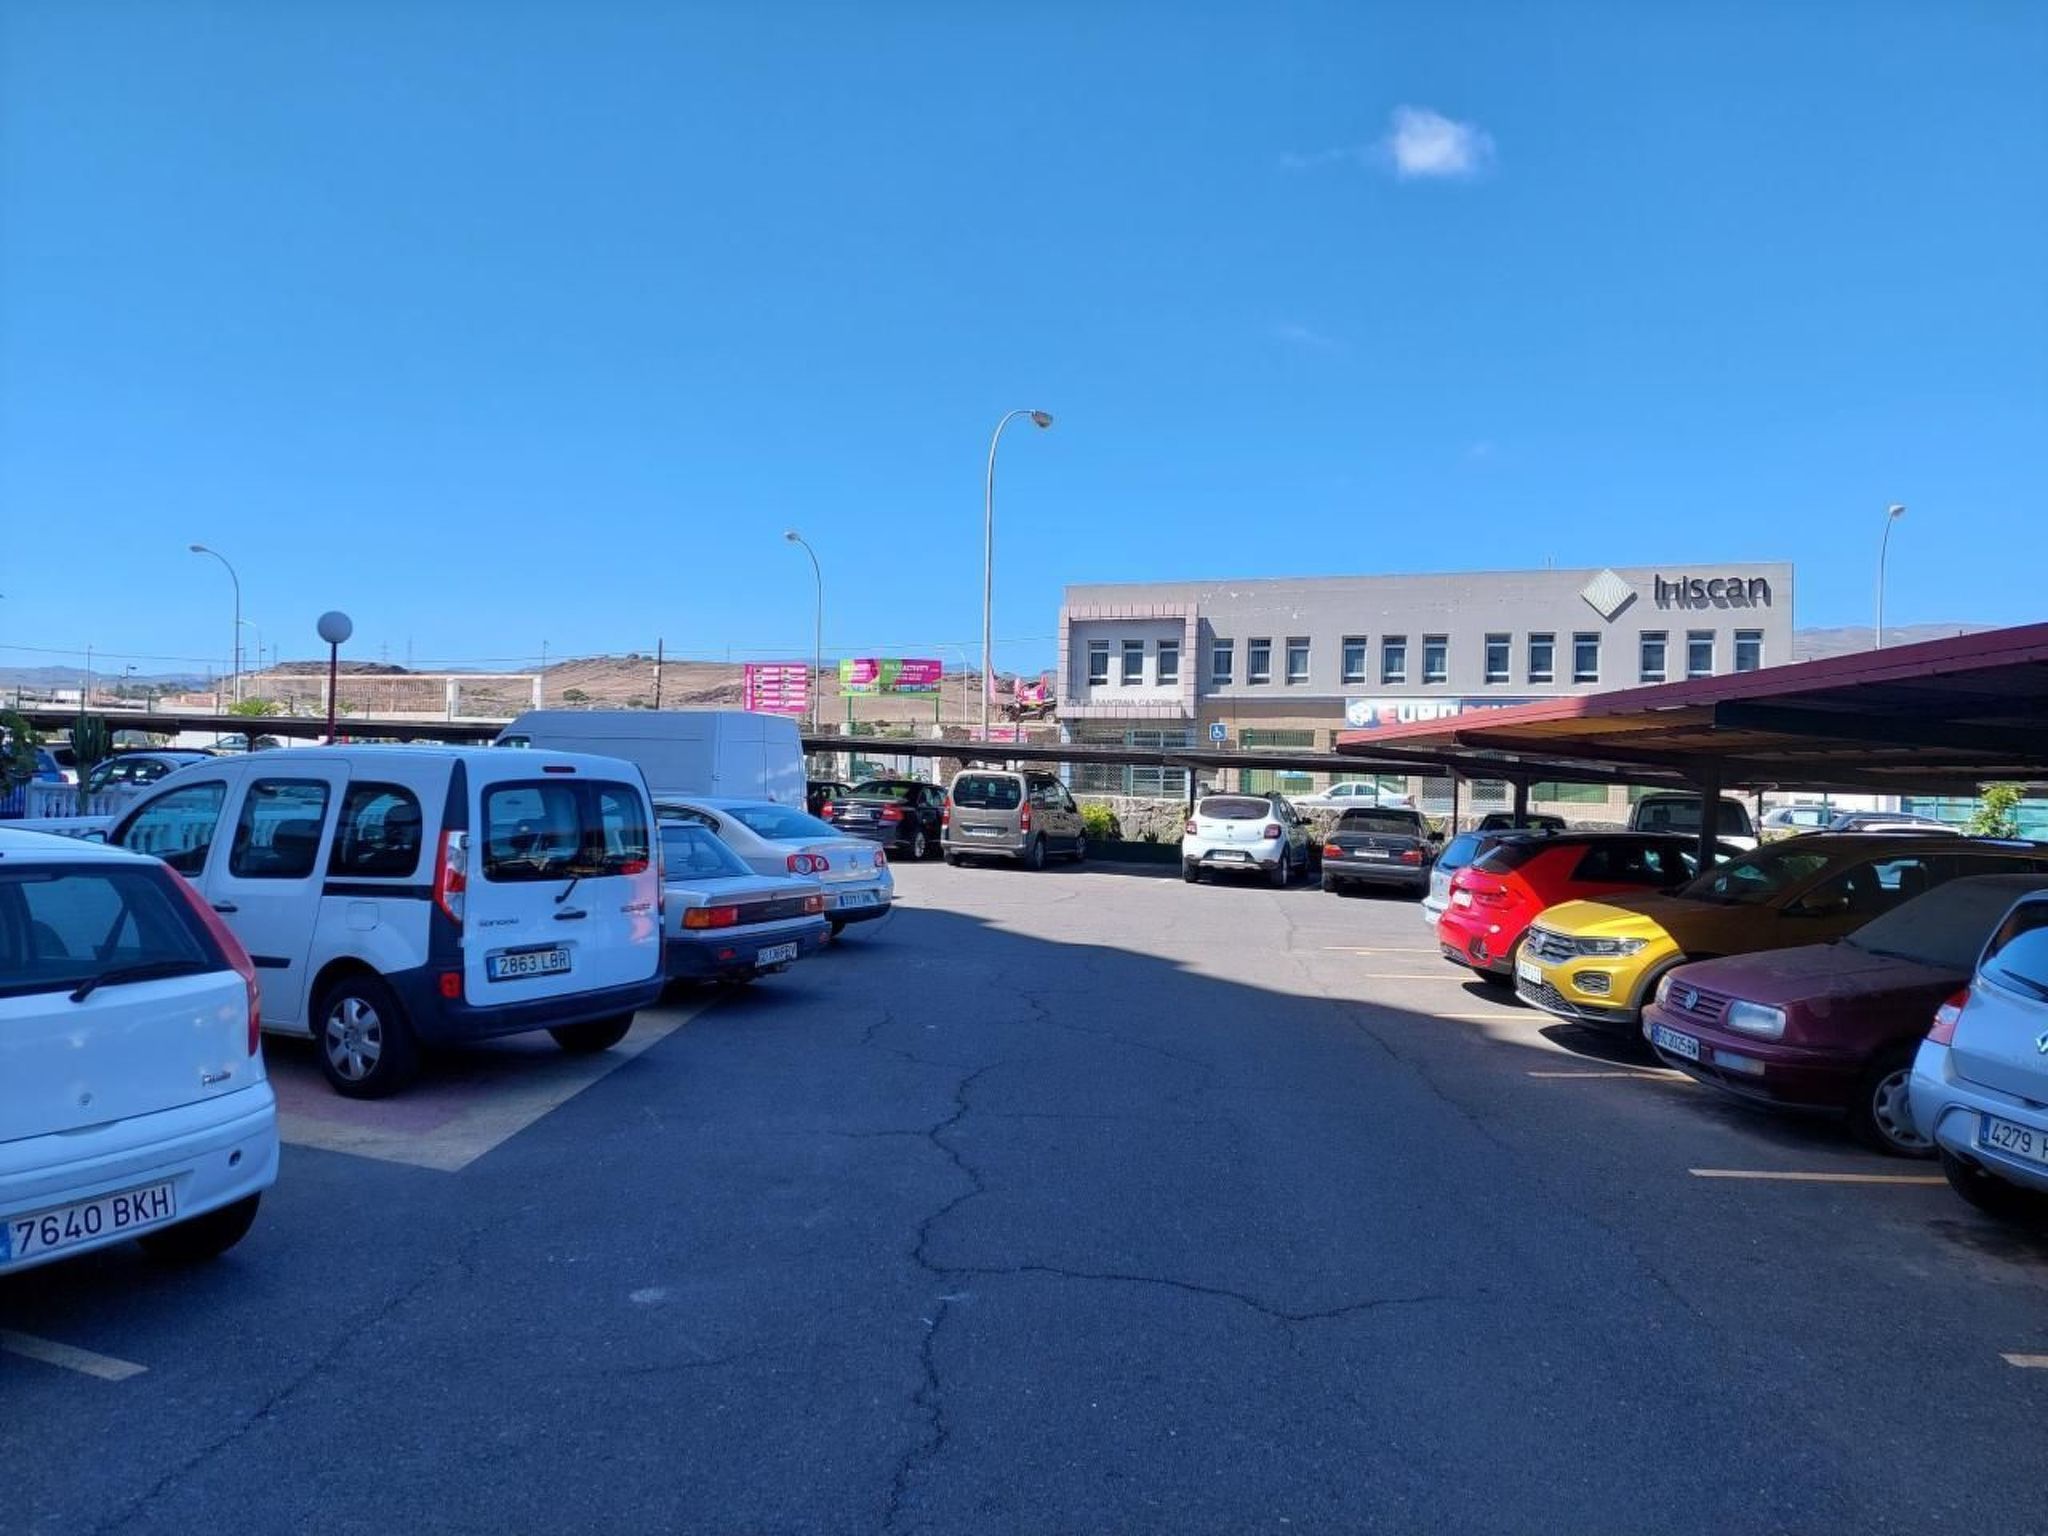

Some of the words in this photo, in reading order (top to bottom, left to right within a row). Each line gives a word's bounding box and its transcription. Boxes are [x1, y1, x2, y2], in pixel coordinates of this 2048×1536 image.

[499, 955, 538, 976] 2863
[541, 951, 567, 970] LBR
[1991, 1122, 2032, 1153] 4279
[16, 1205, 102, 1255] 7640
[112, 1186, 170, 1228] BKH
